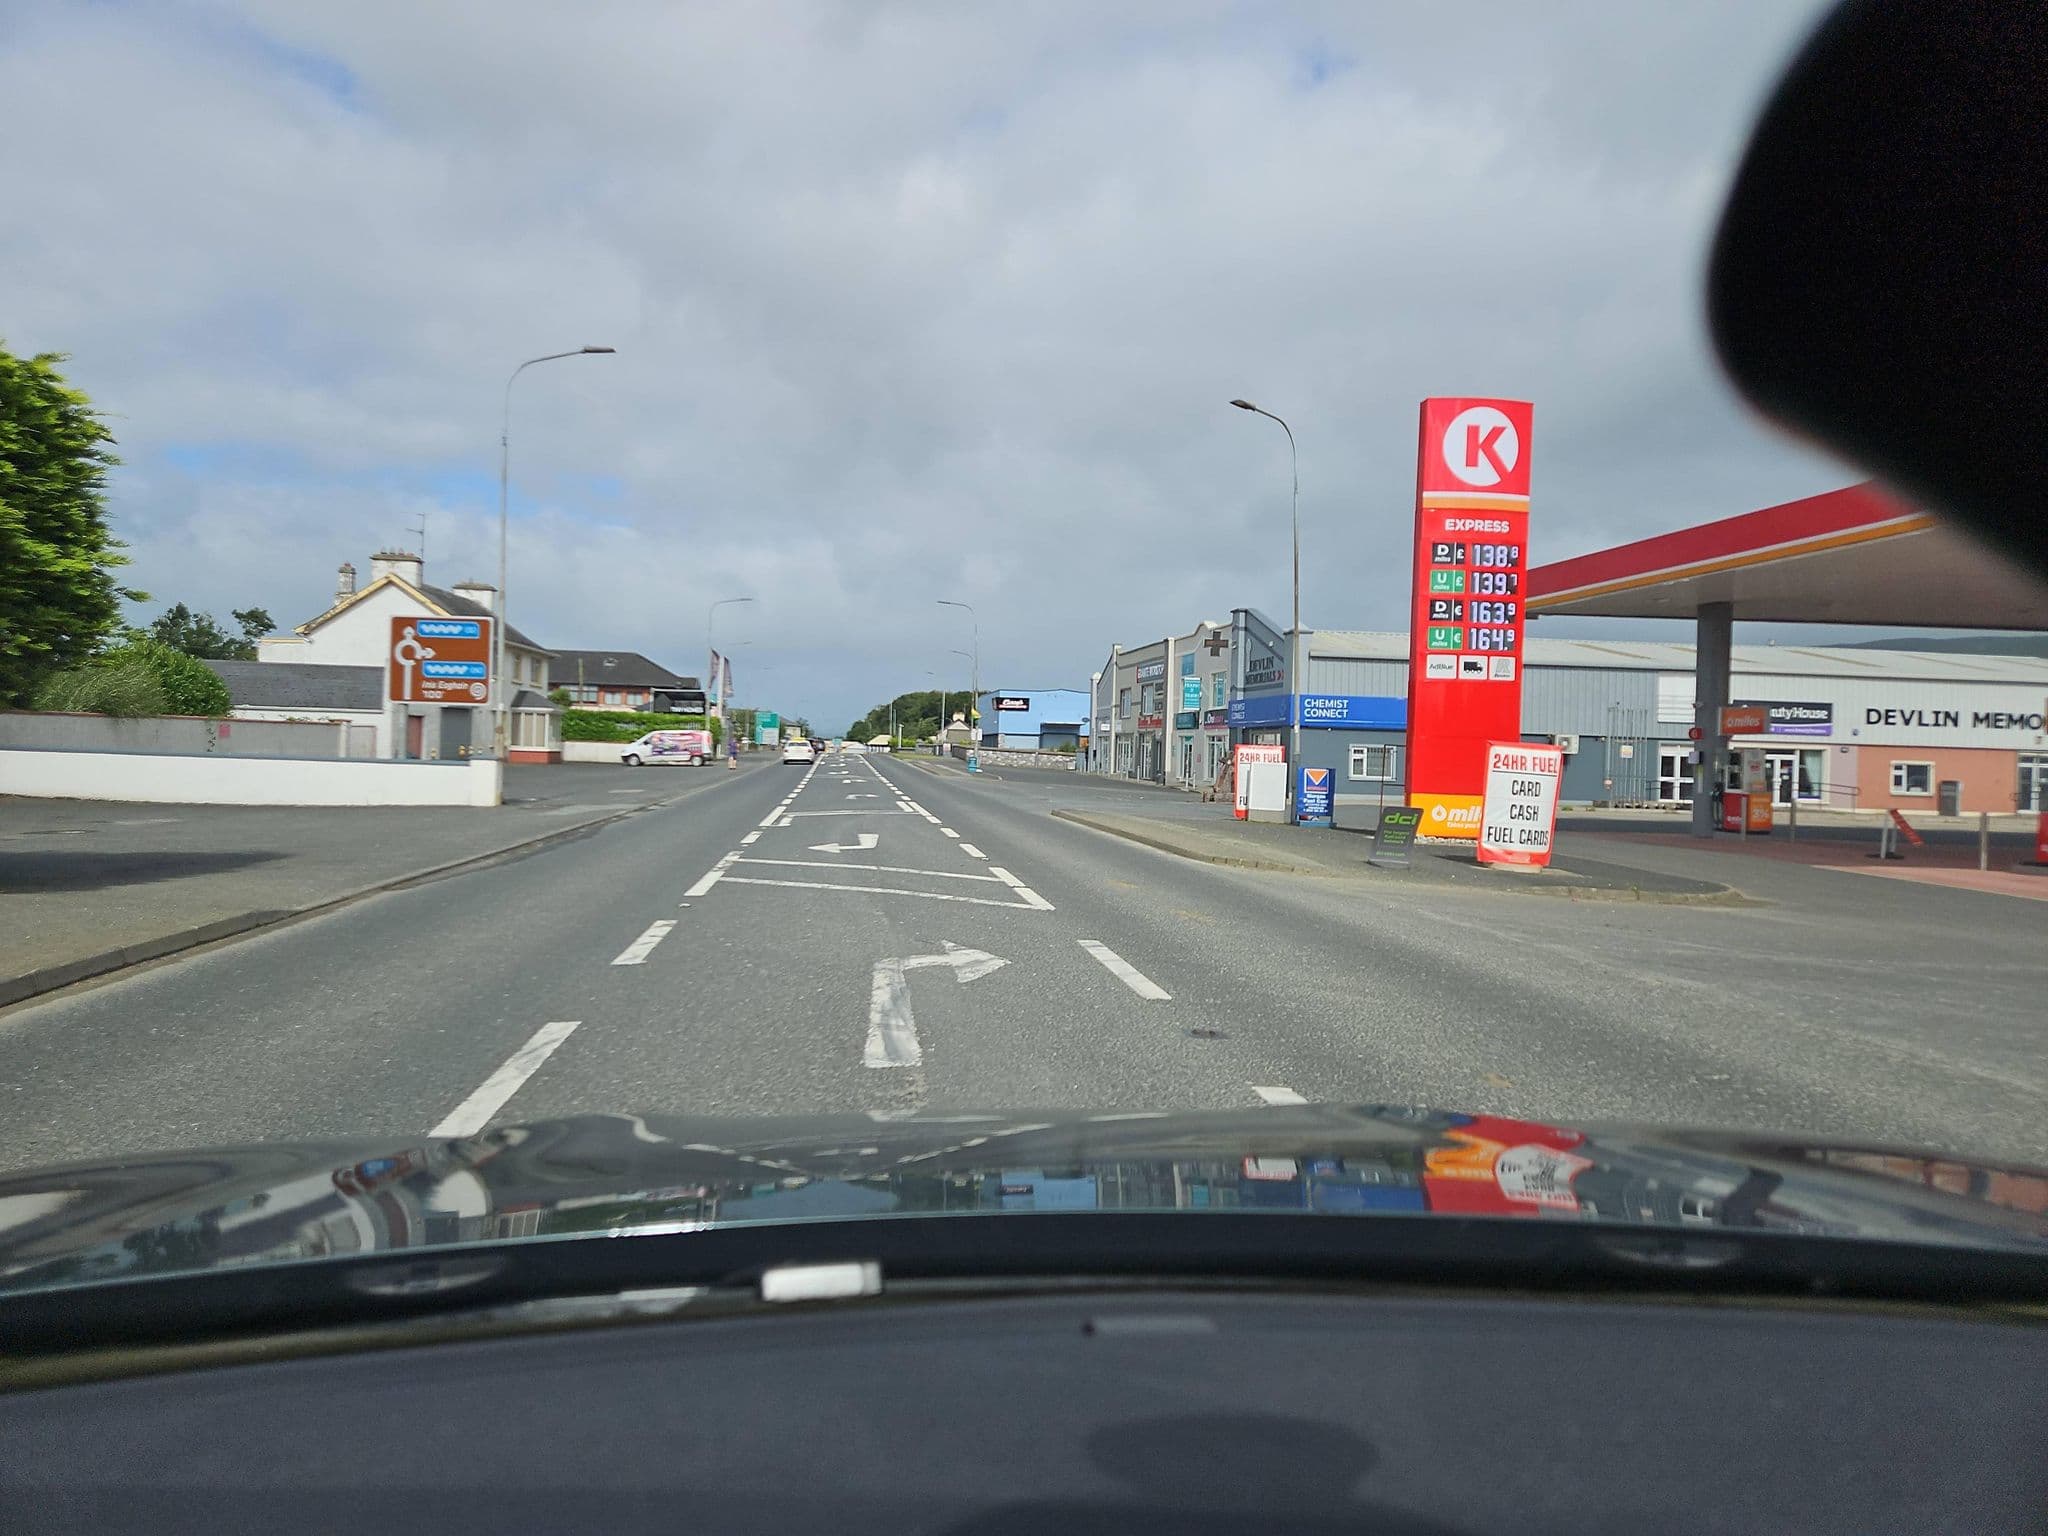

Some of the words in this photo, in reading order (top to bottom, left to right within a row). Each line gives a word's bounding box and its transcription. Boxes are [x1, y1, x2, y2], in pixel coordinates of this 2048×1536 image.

[1465, 424, 1512, 481] K
[1444, 518, 1510, 534] EXPRESS
[1437, 544, 1449, 556] D
[1457, 548, 1465, 560] £
[1437, 572, 1448, 585] U
[1455, 575, 1463, 587] £
[1435, 601, 1447, 613] D
[1455, 604, 1463, 616] €
[1471, 601, 1516, 625] 163.9
[1435, 628, 1446, 641] U
[1454, 632, 1462, 643] €
[1470, 628, 1515, 651] 164.9
[1304, 698, 1349, 709] CHEMIST
[1304, 708, 1349, 718] CONNECT
[1866, 708, 1959, 728] DEVLIN
[1973, 711, 2044, 731] MEMO
[1493, 753, 1528, 771] 24HR
[1532, 756, 1558, 774] FUEL
[1511, 779, 1542, 798] CARD
[1384, 812, 1419, 826] dci
[1447, 805, 1482, 822] mil
[1509, 804, 1540, 821] CASH
[1486, 826, 1515, 844] FUEL
[1519, 829, 1549, 846] CARDS
